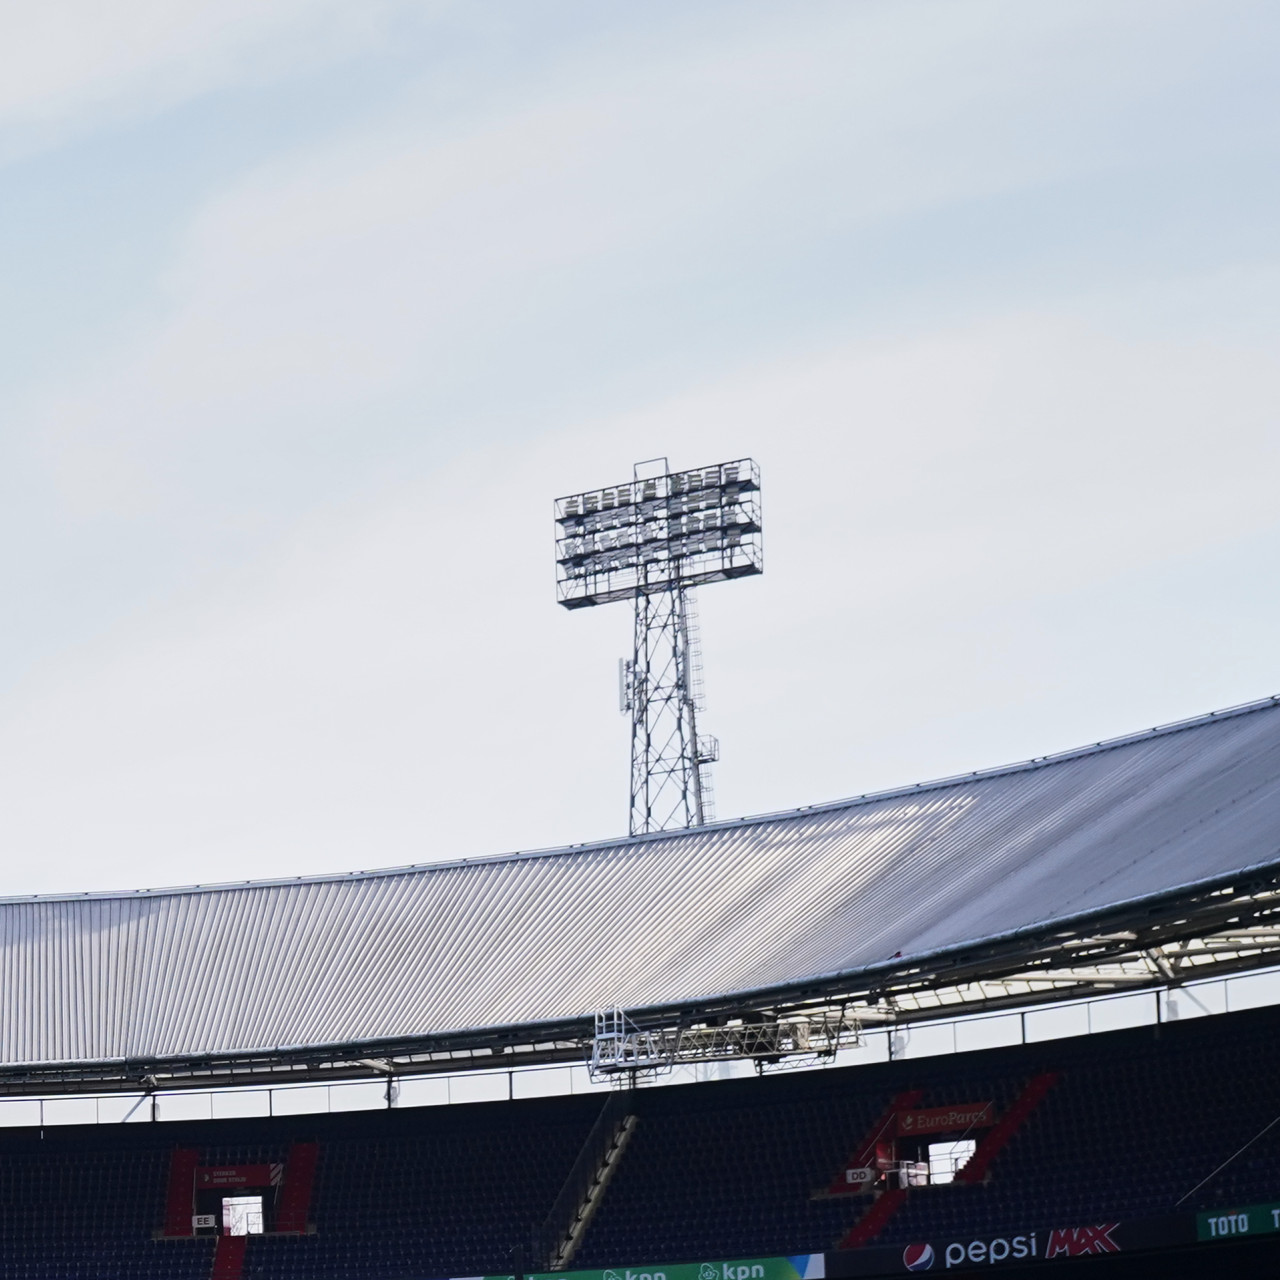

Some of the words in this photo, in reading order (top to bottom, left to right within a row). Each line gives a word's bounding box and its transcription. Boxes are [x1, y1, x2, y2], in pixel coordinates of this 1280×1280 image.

[851, 1171, 867, 1181] DD
[197, 1217, 210, 1225] EE
[1207, 1213, 1250, 1237] TOTO
[945, 1232, 1037, 1269] pepsi
